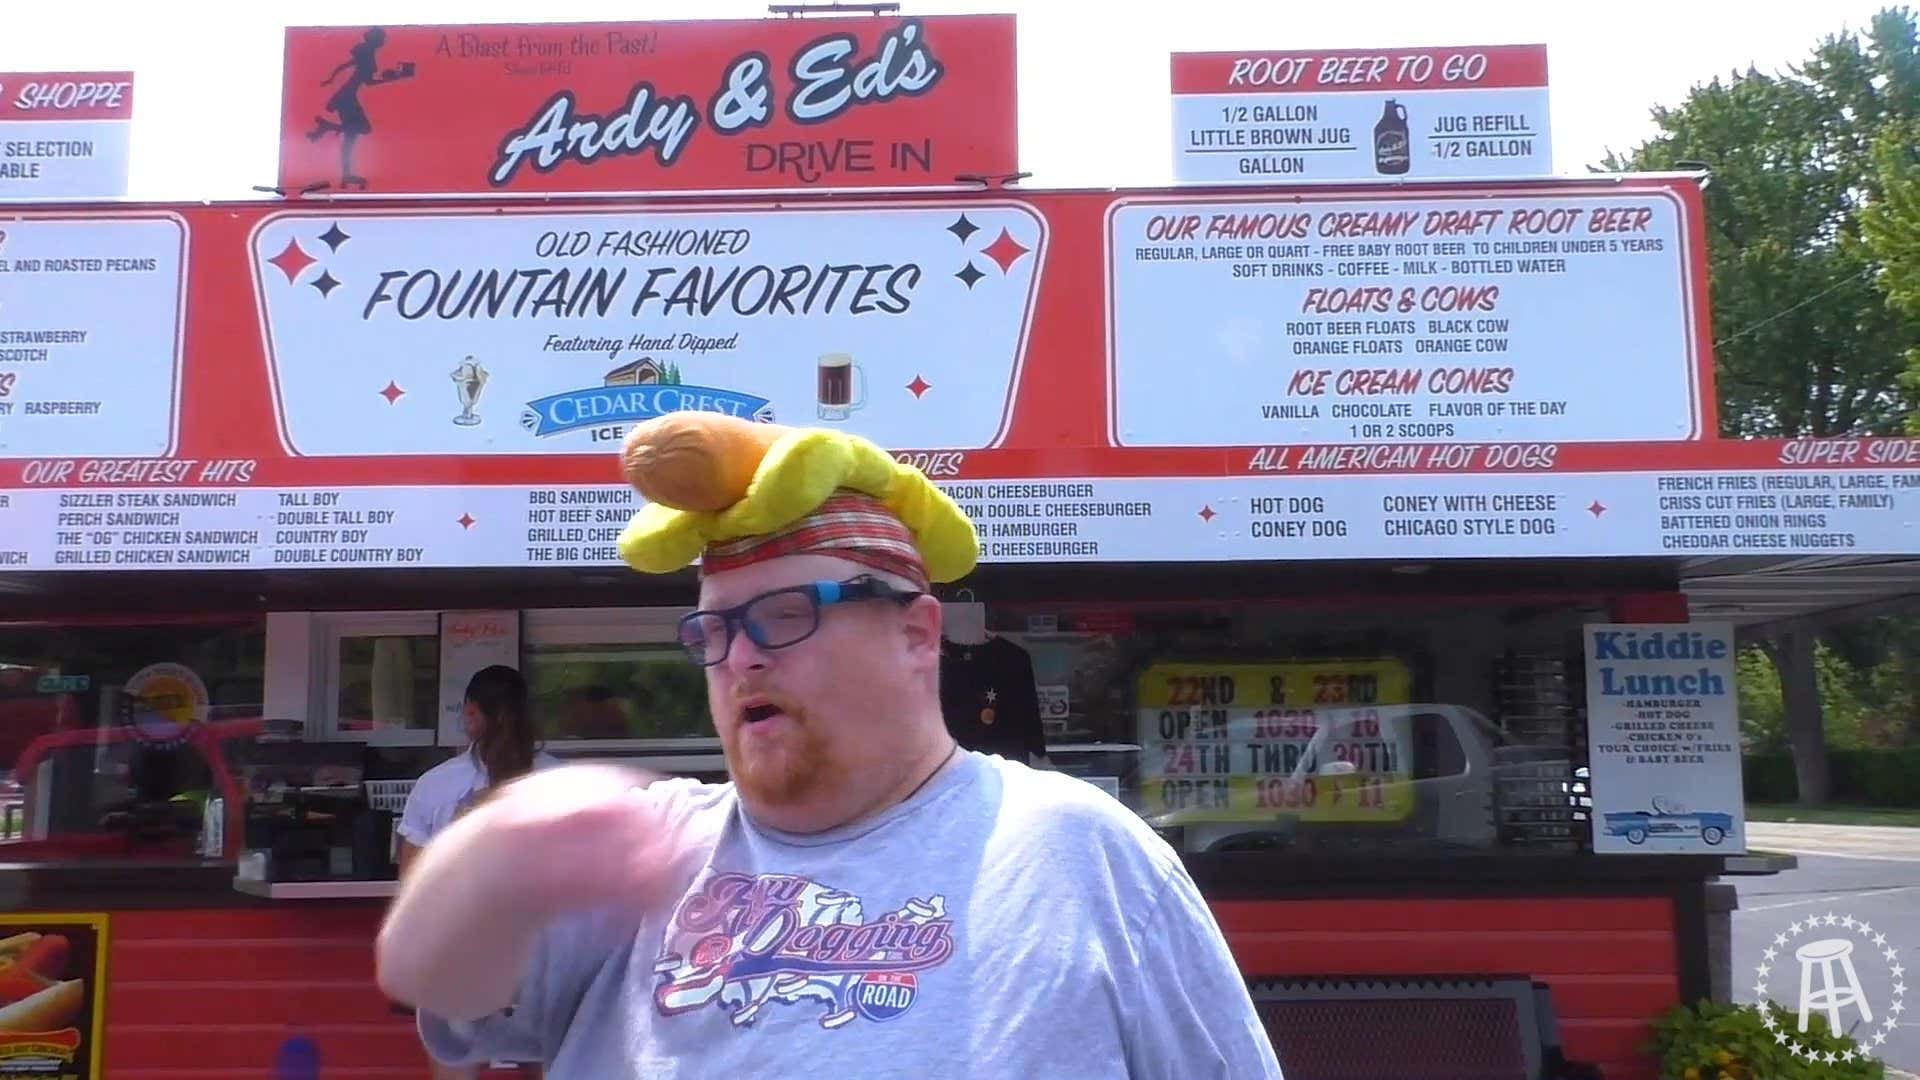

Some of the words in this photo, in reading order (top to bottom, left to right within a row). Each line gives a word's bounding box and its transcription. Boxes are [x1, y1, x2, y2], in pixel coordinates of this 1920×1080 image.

[436, 36, 451, 57] A
[457, 33, 509, 57] Blast
[518, 34, 562, 57] from
[570, 34, 598, 56] the
[607, 30, 658, 55] Past!
[1229, 59, 1312, 86] ROOT
[1316, 57, 1389, 83] BEER
[1396, 55, 1434, 82] TO
[1442, 54, 1488, 81] GO
[15, 82, 131, 109] SHOPPE
[490, 83, 701, 186] Ardy
[709, 53, 774, 133] &
[788, 20, 942, 122] Ed's
[1222, 107, 1247, 122] 1/2
[1253, 105, 1317, 122] GALLON
[1434, 118, 1468, 133] JUG
[1474, 117, 1530, 132] REFILL
[1191, 130, 1245, 146] LITTLE
[1251, 128, 1312, 145] BROWN
[1317, 127, 1350, 144] JUG
[6, 141, 93, 157] SELECTION
[1434, 142, 1460, 158] 1/2
[1466, 140, 1532, 157] GALLON
[746, 140, 874, 183] DRIVE
[890, 138, 930, 171] IN
[1239, 158, 1304, 174] GALLON
[1146, 216, 1200, 241] OUR
[1206, 213, 1312, 240] FAMOUS
[1318, 212, 1419, 237] CREAMY
[1423, 210, 1503, 236] DRAFT
[1508, 208, 1583, 234] ROOT
[1588, 207, 1652, 232] BEER
[535, 231, 590, 257] OLD
[597, 229, 751, 256] FASHIONED
[1136, 247, 1199, 261] REGULAR,
[1202, 247, 1243, 259] LARGE
[1268, 245, 1310, 258] QUART
[1323, 245, 1353, 257] FREE
[1358, 244, 1391, 256] BABY
[1395, 243, 1428, 255] ROOT
[1433, 243, 1466, 255] BEER
[1494, 241, 1558, 253] CHILDREN
[1562, 240, 1606, 253] UNDER
[1622, 239, 1663, 252] YEARS
[13, 260, 40, 272] AND
[44, 259, 102, 271] ROASTED
[106, 259, 156, 271] PECANS
[1233, 264, 1268, 277] SOFT
[1272, 263, 1324, 276] DRINKS
[1338, 263, 1390, 275] COFFEE
[1403, 261, 1438, 275] MILK
[1451, 260, 1513, 273] BOTTLED
[1517, 259, 1566, 273] WATER
[363, 267, 626, 320] FOUNTAIN
[632, 264, 921, 316] FAVORITES
[1303, 287, 1393, 313] FLOATS
[1421, 285, 1499, 311] COWS
[1287, 321, 1322, 335] ROOT
[1327, 321, 1362, 335] BEER
[1366, 320, 1415, 334] FLOATS
[1428, 320, 1473, 333] BLACK
[1477, 319, 1509, 333] COW
[0, 331, 87, 343] STRAWBERRY
[543, 334, 622, 359] Featuring
[628, 334, 676, 352] Hand
[679, 332, 739, 356] Dipped
[1293, 341, 1349, 355] ORANGE
[1353, 340, 1403, 354] FLOATS
[1415, 340, 1471, 353] ORANGE
[1475, 339, 1508, 352] COW
[1287, 369, 1332, 396] ICE
[1335, 369, 1422, 395] CREAM
[1428, 367, 1514, 394] CONES
[25, 401, 102, 414] RASPBERRY
[551, 393, 649, 425] CEDAR
[1262, 406, 1319, 419] VANILLA
[1332, 404, 1412, 418] CHOCOLATE
[1429, 403, 1484, 417] FLAVOR
[591, 427, 623, 442] ICE
[1399, 423, 1454, 438] SCOOPS
[1248, 447, 1290, 471] ALL
[1297, 446, 1419, 470] AMERICAN
[1426, 445, 1478, 469] HOT
[1484, 444, 1557, 468] DOGS
[1778, 440, 1860, 464] SUPER
[22, 461, 73, 484] OUR
[79, 460, 197, 483] GREATEST
[200, 460, 256, 482] HITS
[988, 484, 1093, 498] CHEESEBURGER
[1658, 477, 1712, 490] FRENCH
[1717, 476, 1756, 490] FRIES
[1762, 475, 1835, 492] (REGULAR,
[1840, 475, 1889, 490] LARGE,
[60, 494, 113, 507] SIZZLER
[118, 494, 160, 507] STEAK
[164, 493, 236, 506] SANDWICH
[560, 489, 632, 504] SANDWICH
[1383, 496, 1438, 512] CONEY
[1444, 495, 1488, 511] WITH
[1493, 494, 1557, 511] CHEESE
[1660, 496, 1701, 510] CRISS
[1736, 495, 1776, 509] FRIES
[1838, 494, 1894, 509] FAMILY)
[988, 504, 1041, 518] DOUBLE
[1045, 502, 1152, 517] CHEESEBURGER
[1250, 498, 1282, 513] HOT
[1287, 497, 1324, 513] DOG
[58, 513, 102, 526] PERCH
[106, 512, 180, 526] SANDWICH
[277, 511, 328, 525] DOUBLE
[528, 509, 556, 523] HOT
[559, 509, 592, 522] BEEF
[1661, 515, 1731, 529] BATTERED
[1735, 514, 1778, 528] ONION
[1783, 514, 1827, 528] RINGS
[527, 527, 584, 542] GRILLED
[992, 522, 1077, 537] HAMBURGER
[1251, 522, 1307, 538] CONEY
[1311, 522, 1348, 537] DOG
[1384, 520, 1458, 536] CHICAGO
[1462, 519, 1514, 535] STYLE
[1519, 518, 1556, 534] DOG
[123, 531, 181, 545] CHICKEN
[185, 530, 258, 545] SANDWICH
[276, 530, 337, 544] COUNTRY
[1663, 534, 1728, 548] CHEDDAR
[1732, 533, 1787, 548] CHEESE
[1790, 533, 1855, 548] NUGGETS
[55, 550, 111, 564] GRILLED
[115, 550, 173, 564] CHICKEN
[176, 549, 250, 563] SANDWICH
[274, 549, 326, 563] DOUBLE
[330, 549, 393, 562] COUNTRY
[397, 548, 424, 562] BOY
[992, 541, 1098, 556] CHEESEBURGER
[1593, 631, 1727, 660] Kiddie
[1599, 667, 1725, 696] Lunch
[1167, 676, 1235, 705] 22ND
[1159, 710, 1228, 739] OPEN
[1252, 709, 1317, 738] 1030
[1163, 743, 1230, 774] 24TH
[1162, 779, 1229, 808] OPEN
[862, 984, 912, 1008] ROAD
